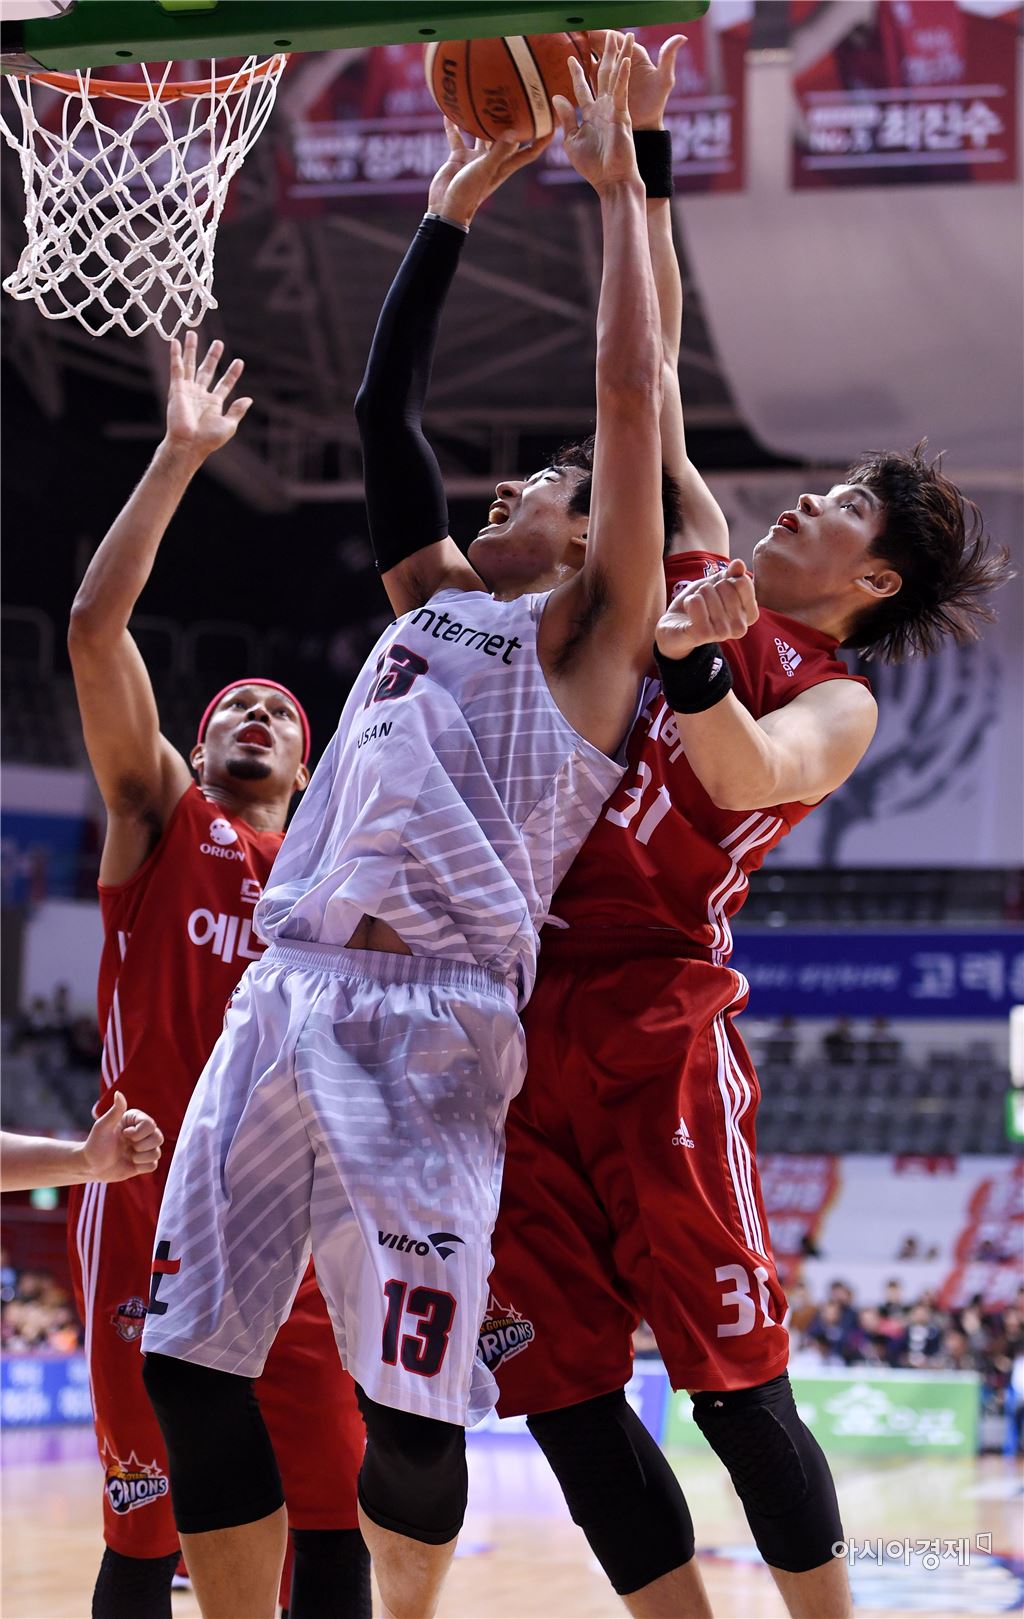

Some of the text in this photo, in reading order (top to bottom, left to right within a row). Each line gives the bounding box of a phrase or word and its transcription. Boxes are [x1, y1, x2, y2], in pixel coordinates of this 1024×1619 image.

[391, 608, 522, 665] nternet
[774, 637, 795, 678] adidas
[357, 721, 393, 749] USAN
[200, 844, 246, 862] ORION
[378, 1230, 430, 1257] vitro
[381, 1278, 457, 1378] 13
[109, 1479, 166, 1508] ORIONS
